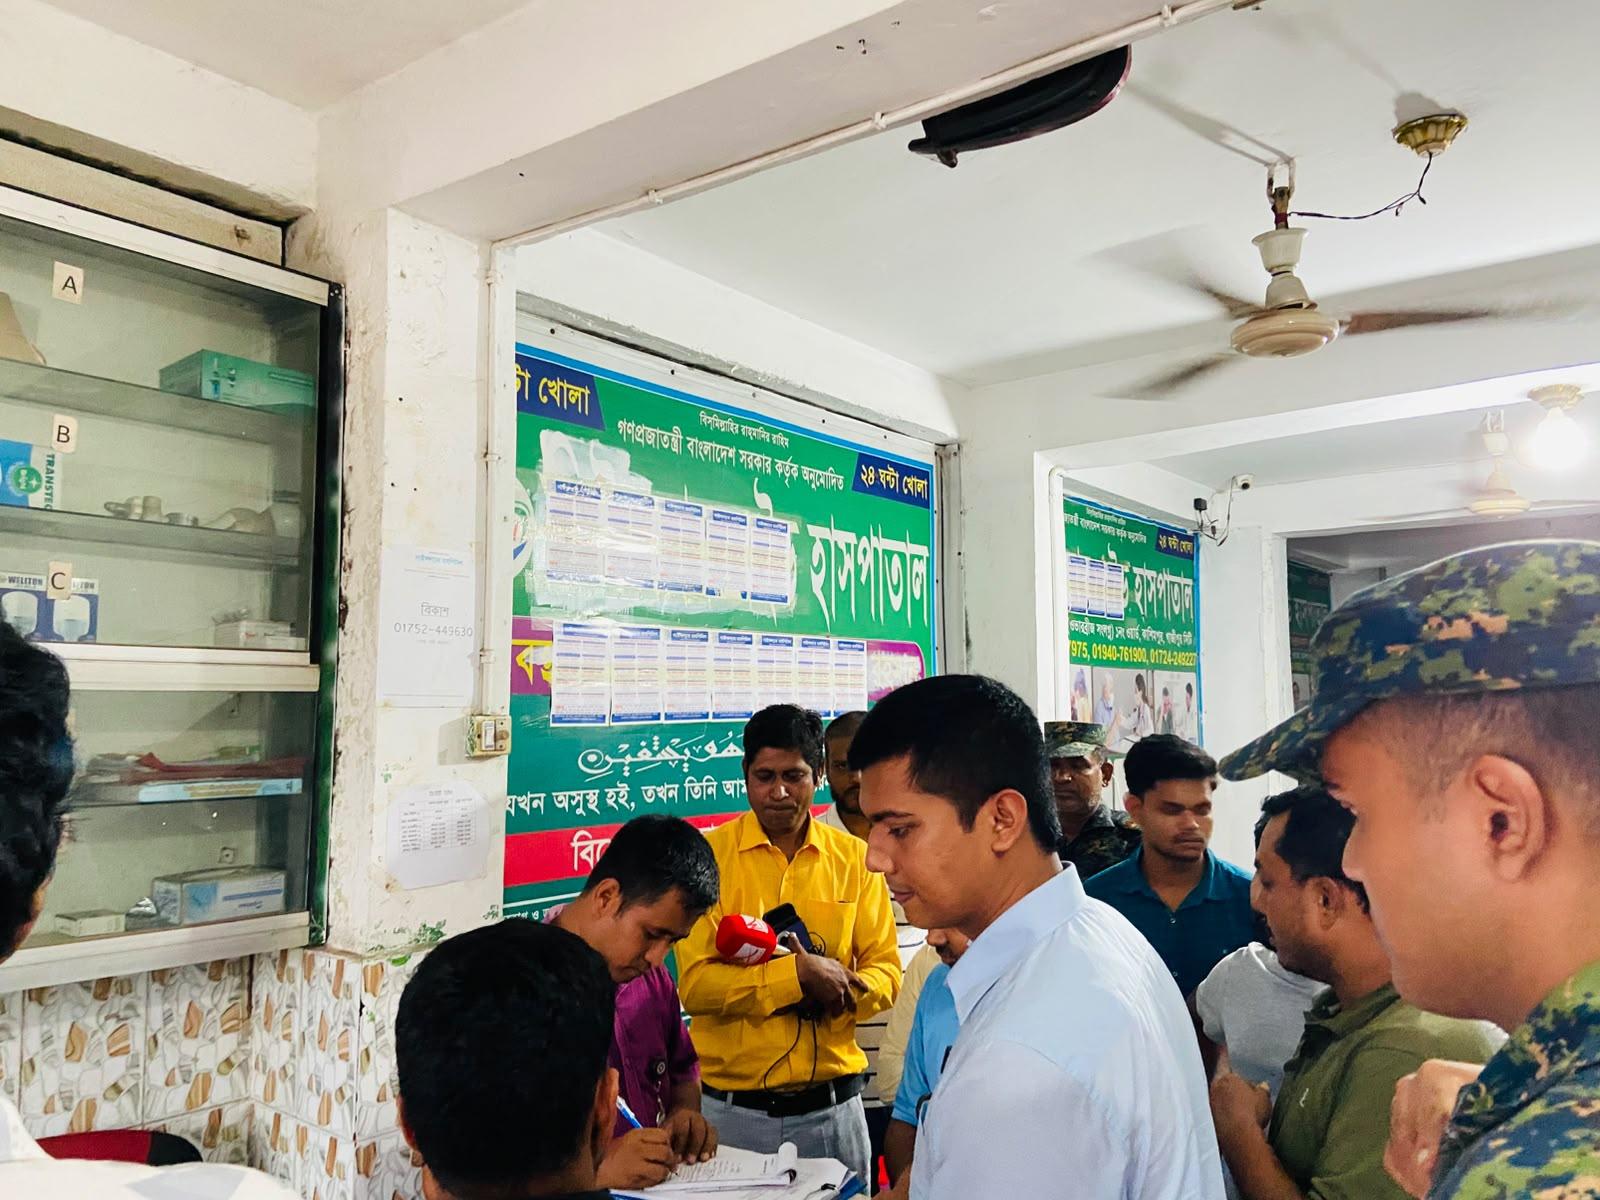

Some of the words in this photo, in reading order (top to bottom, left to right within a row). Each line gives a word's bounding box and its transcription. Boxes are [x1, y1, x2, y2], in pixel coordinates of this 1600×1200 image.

[62, 276, 77, 294] A
[539, 376, 591, 416] খোলা
[56, 425, 70, 443] B
[617, 418, 684, 455] গণপ্রজাতন্ত্রী
[685, 436, 737, 467] বাংলাদেশ
[738, 449, 772, 476] সরকার
[774, 455, 799, 489] কর্তৃক
[800, 466, 845, 491] অনুমোদিত
[860, 464, 876, 488] ২৪
[902, 474, 929, 500] খোলা
[51, 572, 66, 590] C
[806, 513, 930, 633] হাসপাতাল
[1132, 561, 1194, 624] হাসপাতাল
[1069, 640, 1091, 661] 975,
[552, 790, 601, 816] অসুস্থ
[605, 781, 636, 811] হই,
[641, 782, 679, 805] তখন
[683, 775, 718, 803] তিনি
